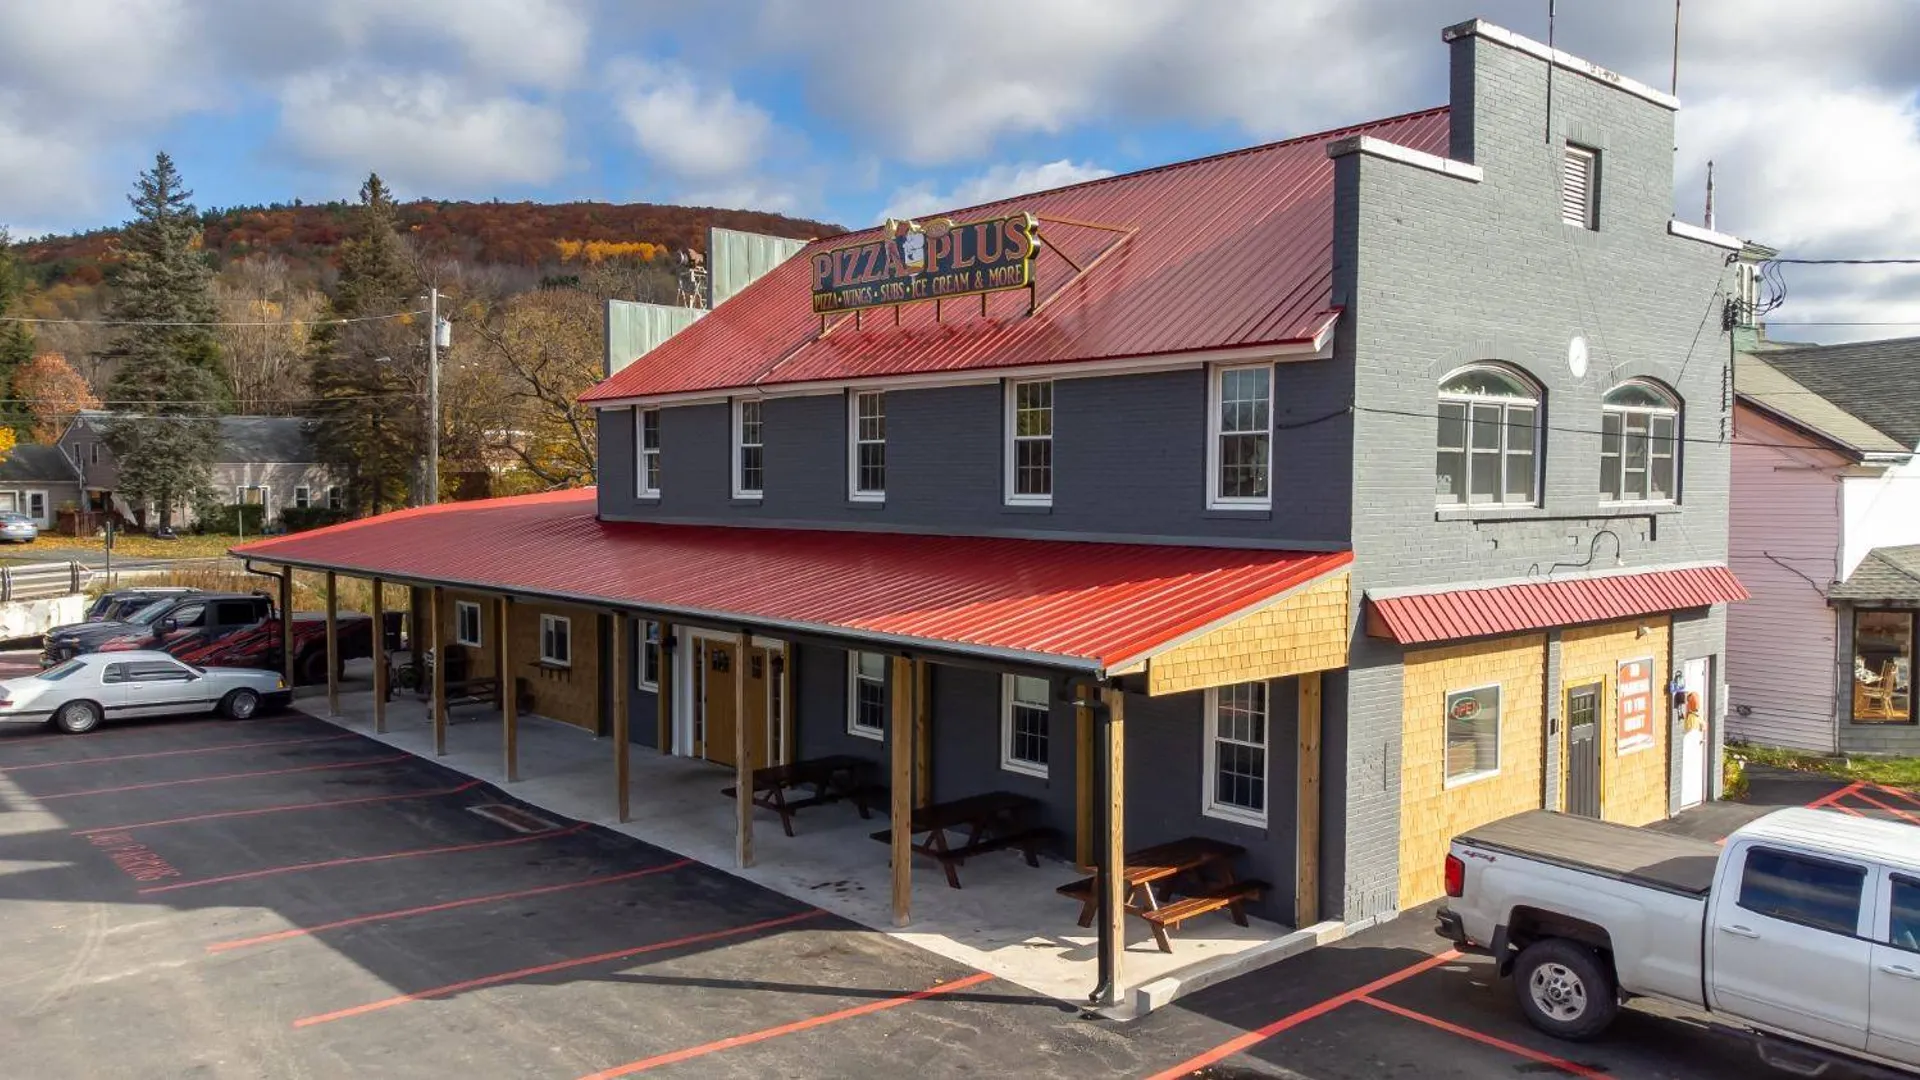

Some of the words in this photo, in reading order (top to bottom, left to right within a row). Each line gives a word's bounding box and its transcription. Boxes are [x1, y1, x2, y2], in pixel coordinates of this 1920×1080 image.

[813, 238, 907, 291] PIZZA
[926, 217, 1028, 273] PLUS
[814, 293, 838, 310] PIZZA
[842, 287, 872, 306] WINGS
[881, 281, 904, 301] SUBS
[911, 277, 927, 299] ICE
[932, 273, 970, 295] CREAM
[975, 270, 985, 289] &
[989, 264, 1023, 288] MORE
